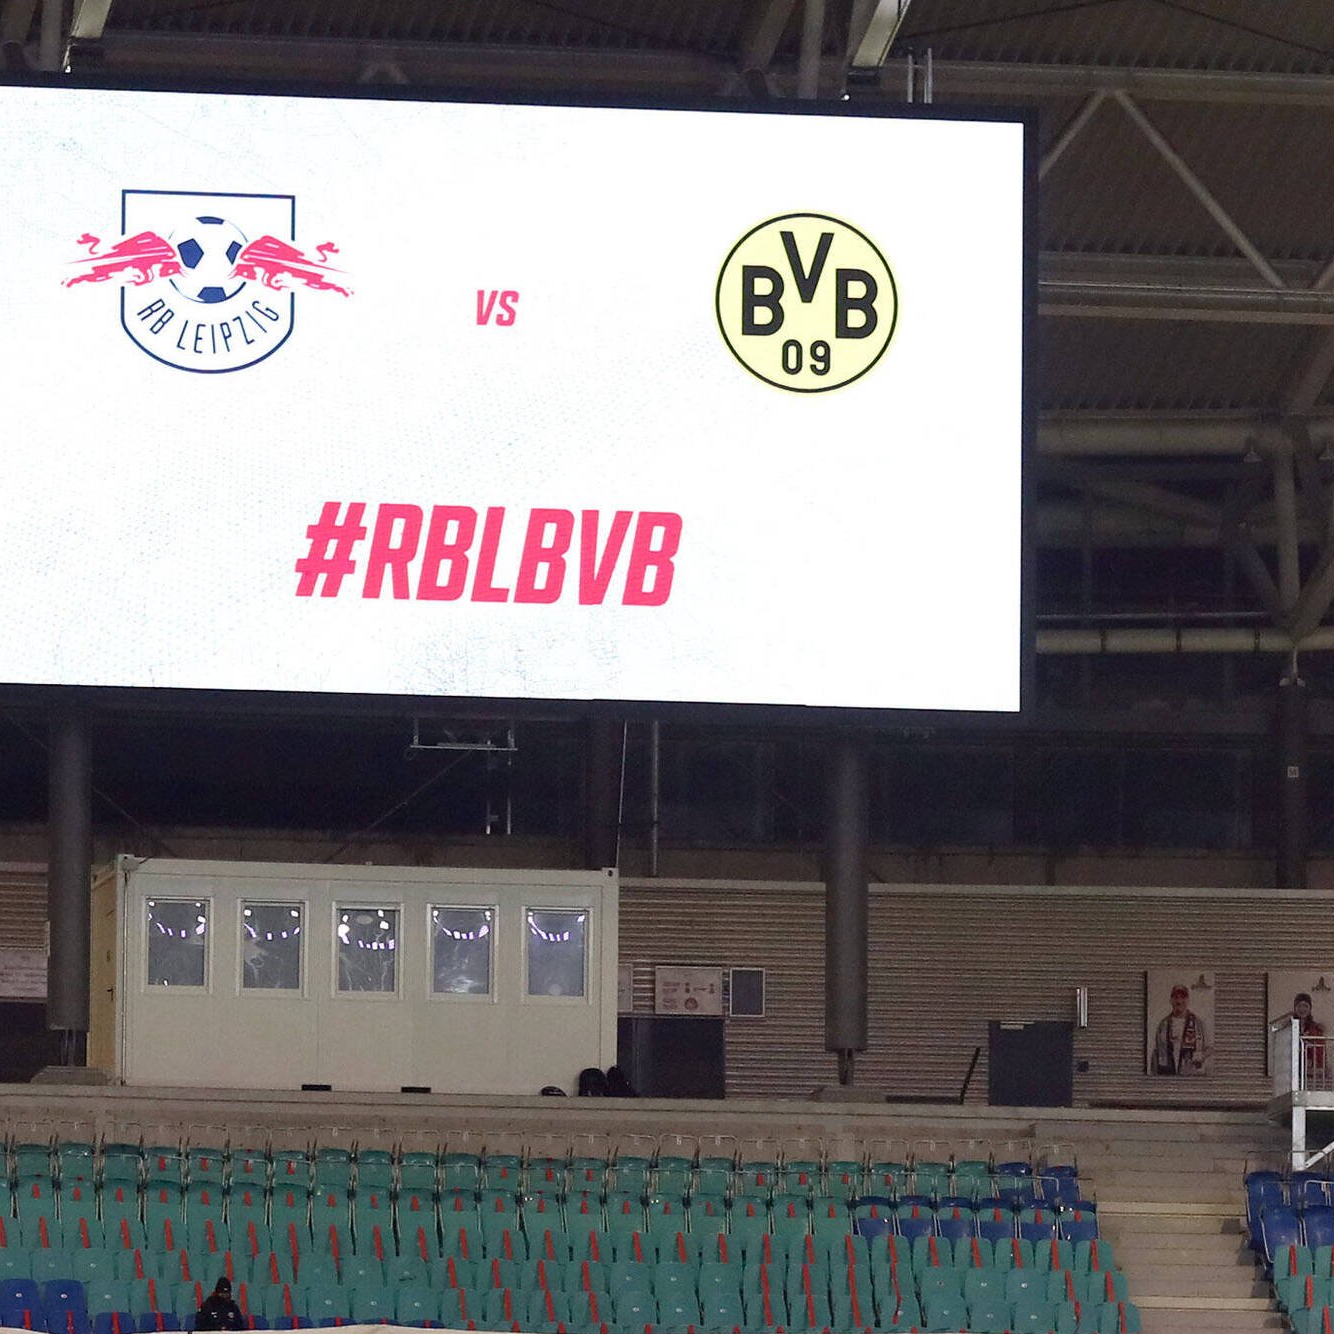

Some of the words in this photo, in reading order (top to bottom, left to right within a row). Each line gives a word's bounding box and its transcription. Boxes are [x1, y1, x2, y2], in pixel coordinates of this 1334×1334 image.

[475, 289, 519, 327] VS
[741, 230, 879, 339] BVB
[137, 298, 175, 335] RB
[176, 299, 280, 355] LEIPZIG
[781, 338, 832, 376] 09
[294, 501, 684, 607] #RBLBVB
